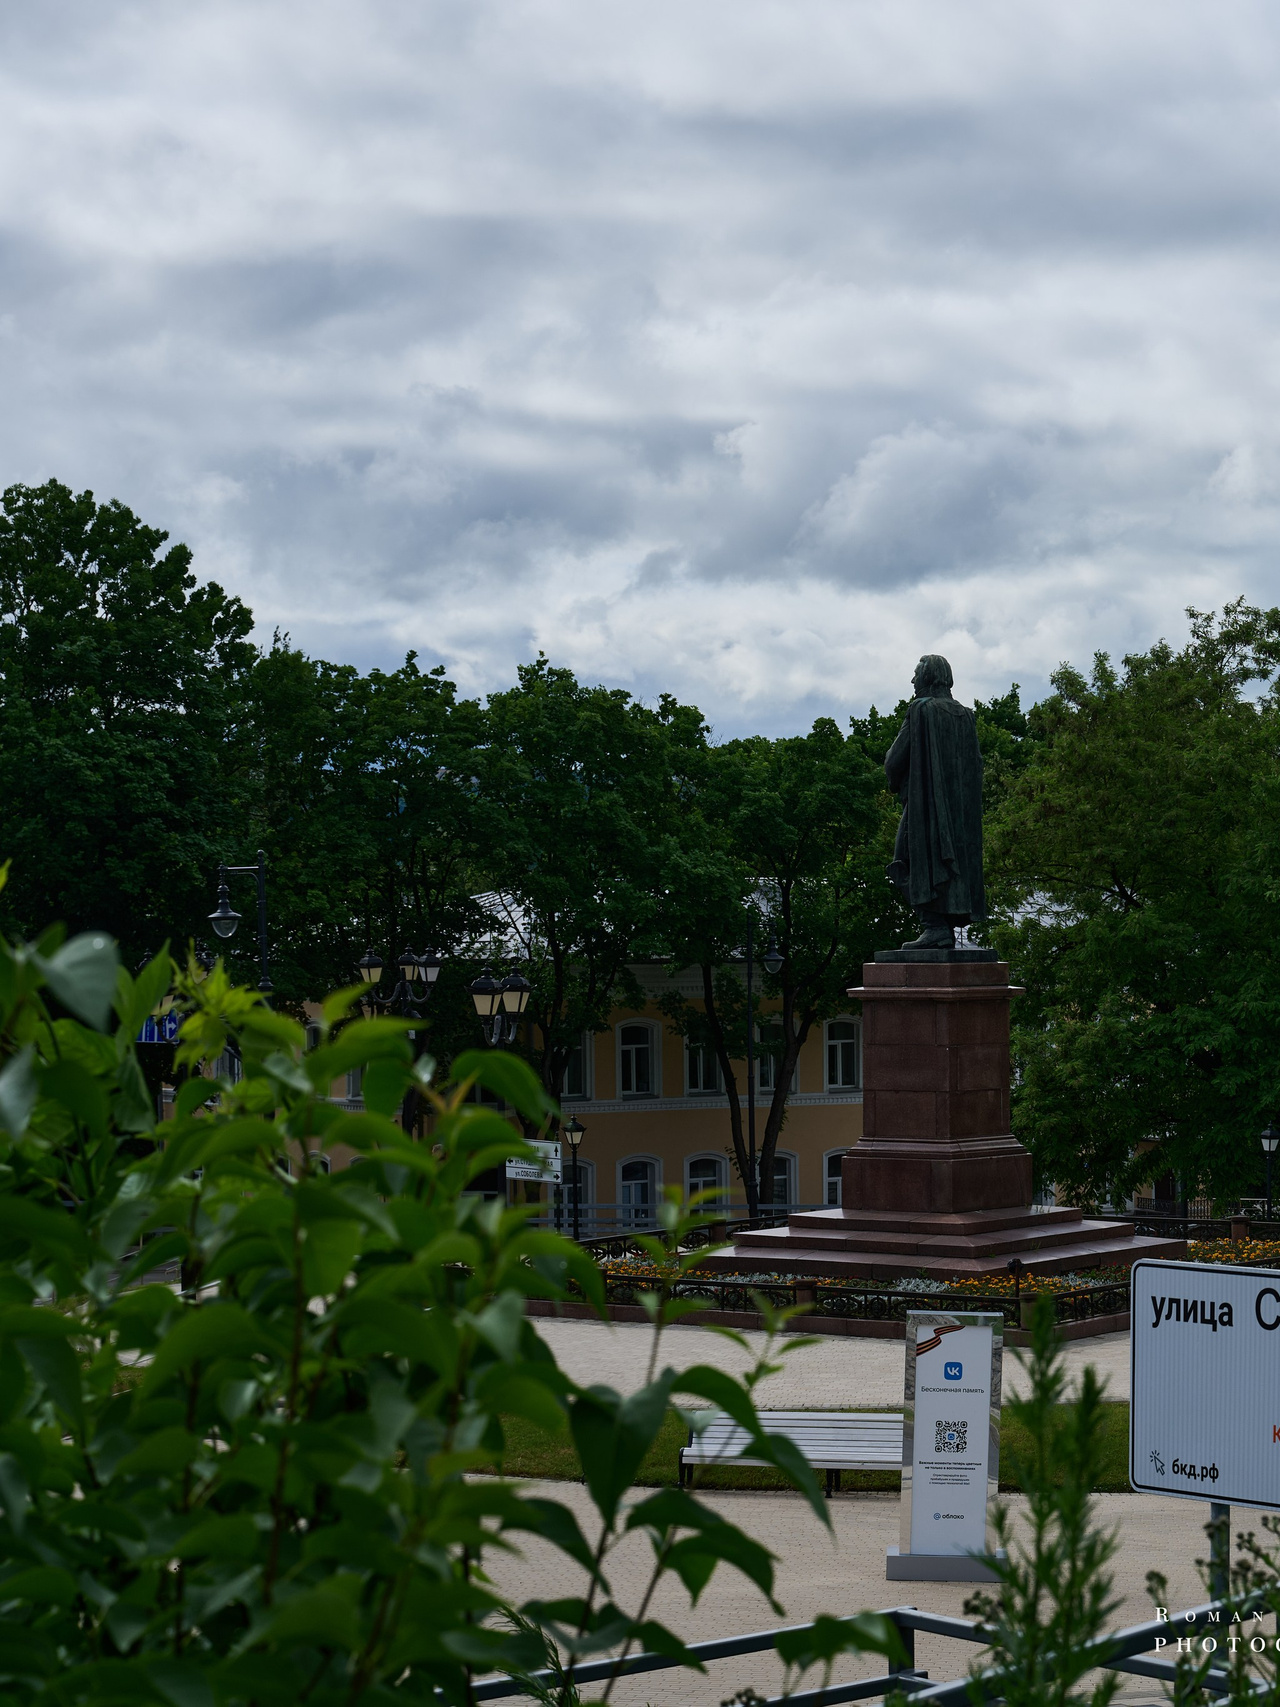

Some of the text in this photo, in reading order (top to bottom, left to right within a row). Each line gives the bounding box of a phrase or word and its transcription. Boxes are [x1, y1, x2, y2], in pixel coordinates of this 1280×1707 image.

[1150, 1294, 1235, 1331] улица
[921, 1385, 962, 1393] Бесконечная
[1172, 1457, 1220, 1483] бкд.рф
